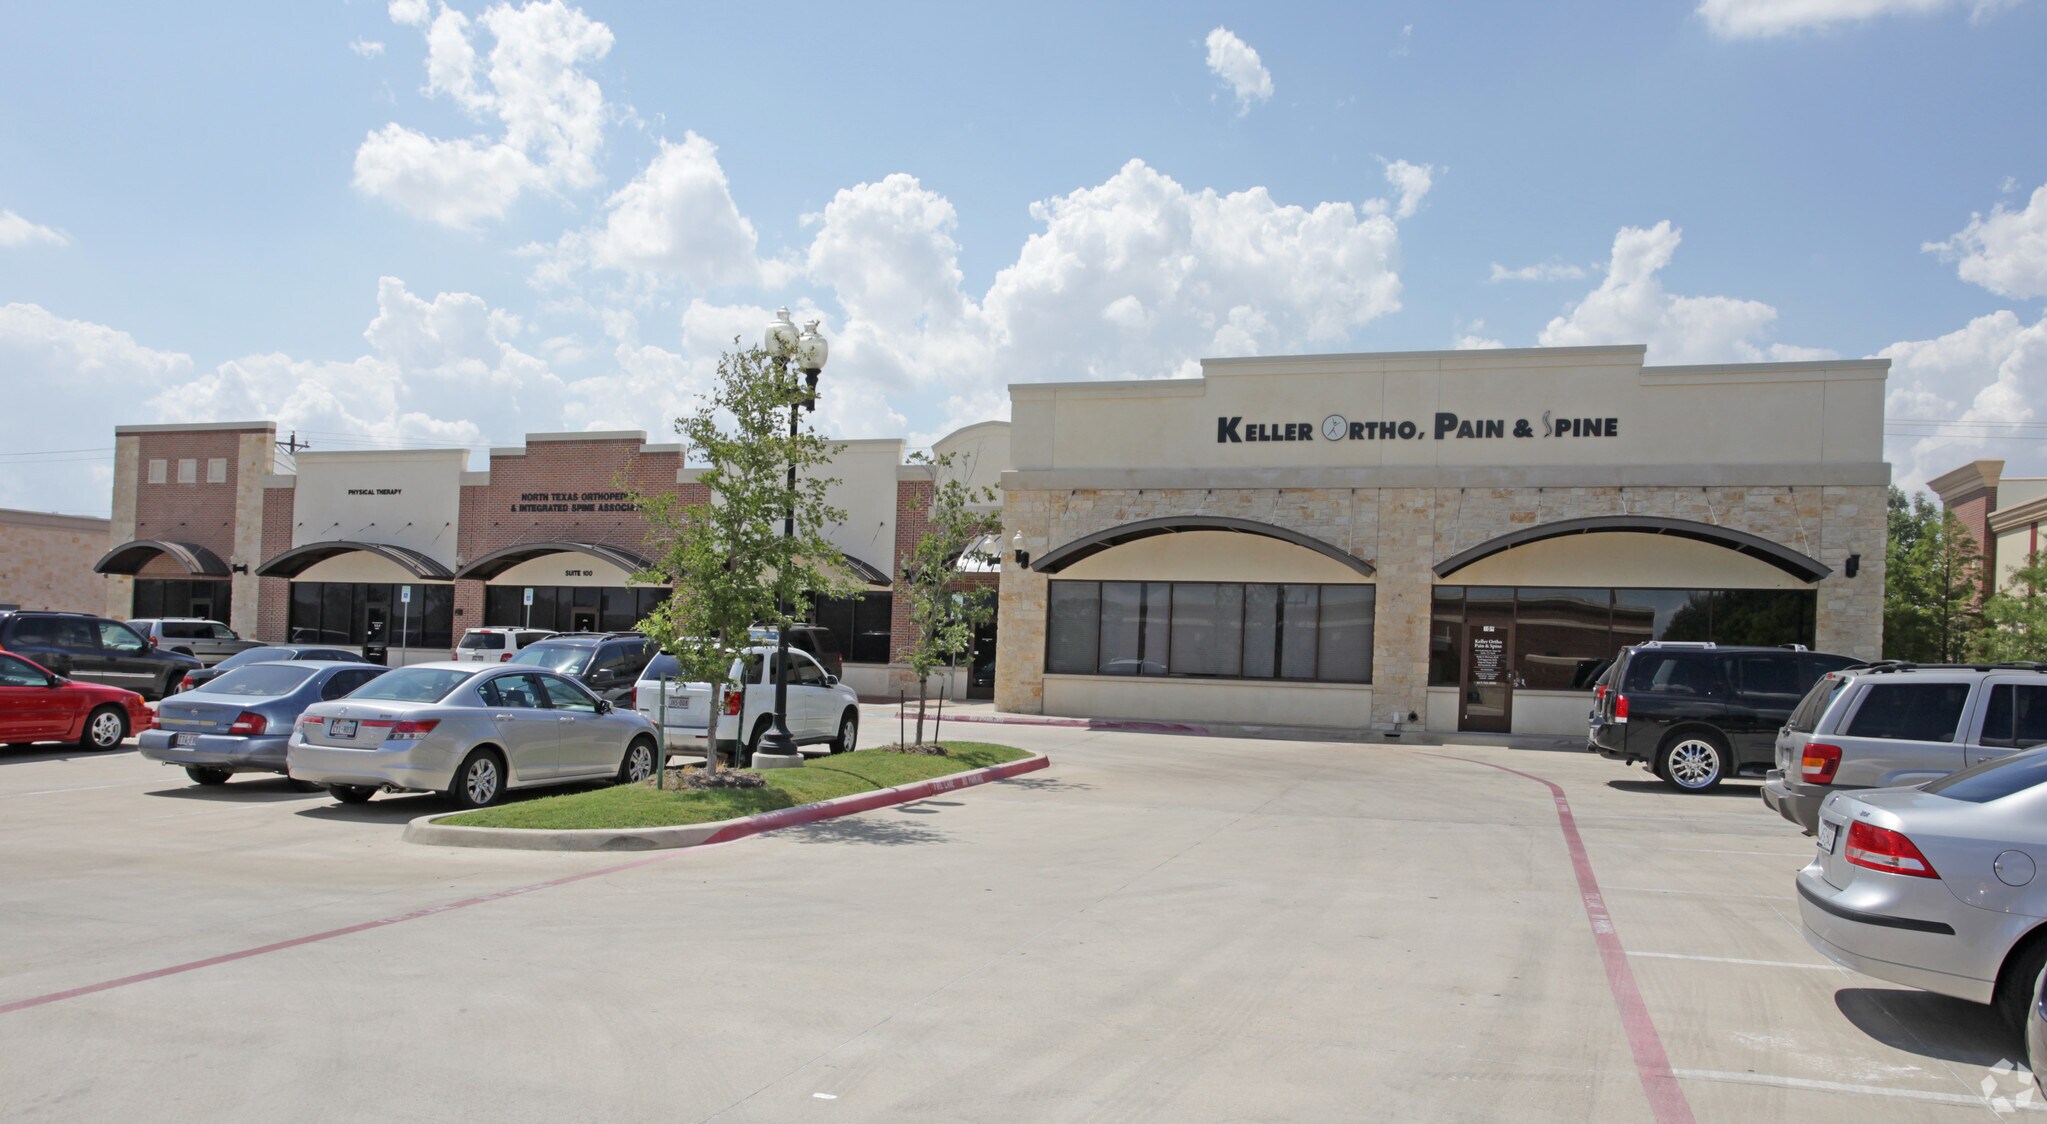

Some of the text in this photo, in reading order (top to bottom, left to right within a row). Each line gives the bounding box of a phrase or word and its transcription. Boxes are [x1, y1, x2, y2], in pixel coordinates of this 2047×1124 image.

[1513, 418, 1534, 438] &
[521, 493, 548, 501] NORTH
[511, 504, 516, 512] &
[520, 504, 568, 512] INTEGRATED
[571, 504, 595, 512] SPINE
